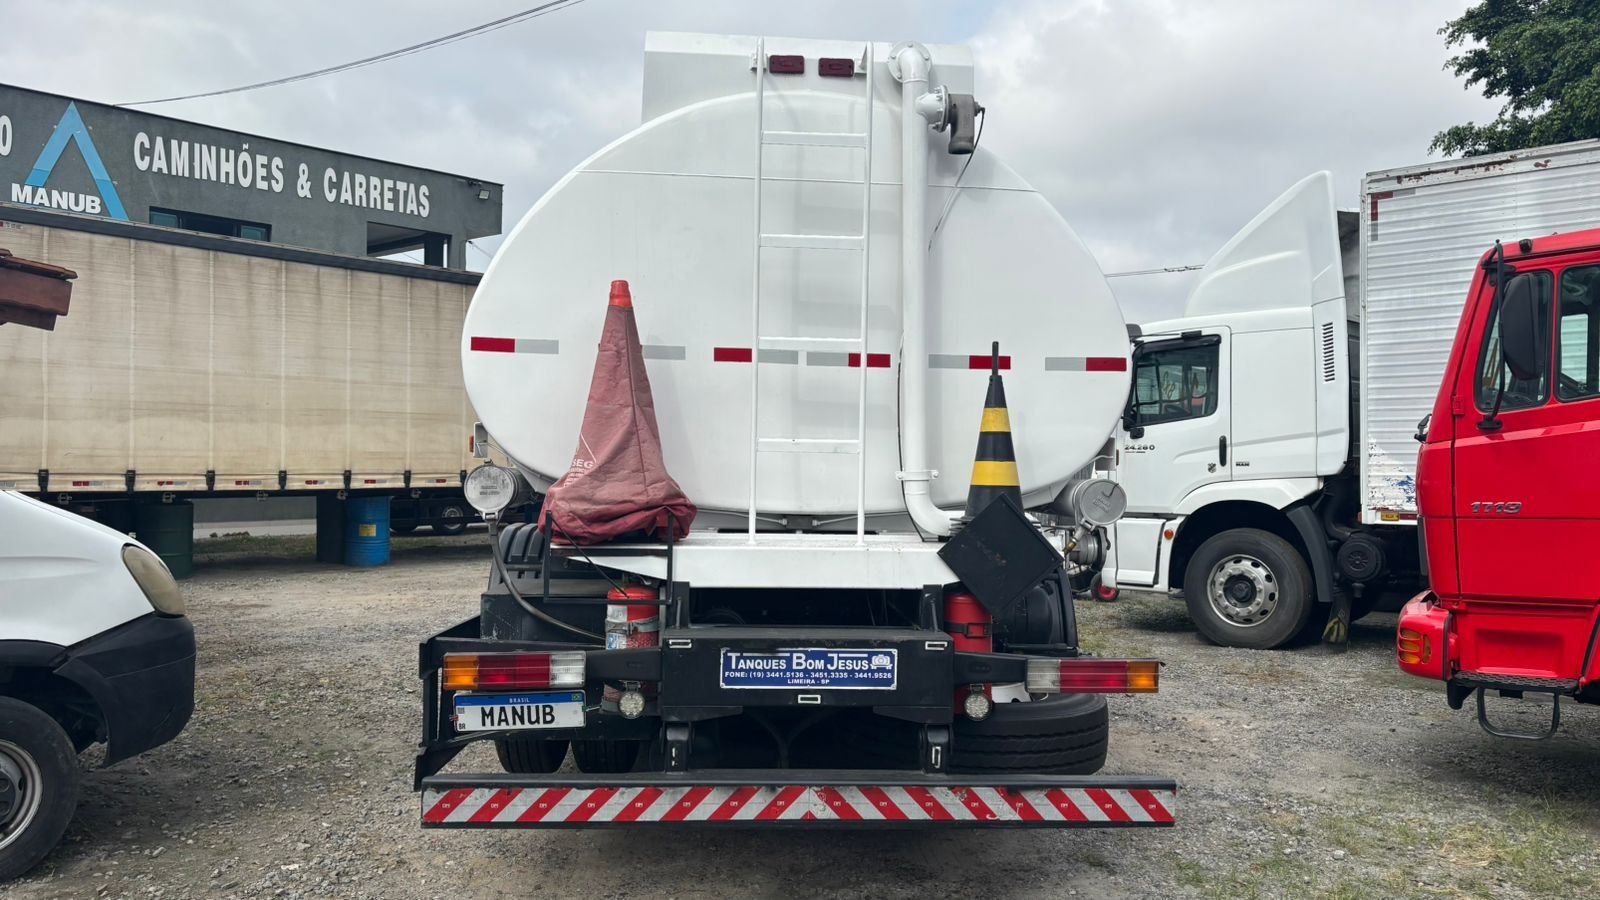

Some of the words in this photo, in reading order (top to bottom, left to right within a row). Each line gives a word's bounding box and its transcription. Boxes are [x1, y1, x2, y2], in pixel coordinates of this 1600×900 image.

[134, 131, 284, 193] CAMINHÕES
[297, 163, 312, 199] &
[323, 167, 430, 218] CARRETAS
[11, 183, 101, 214] MANUB
[727, 653, 786, 670] TANQUES
[792, 653, 824, 670] BOM
[827, 653, 869, 670] JESUS
[481, 704, 555, 727] MANUB
